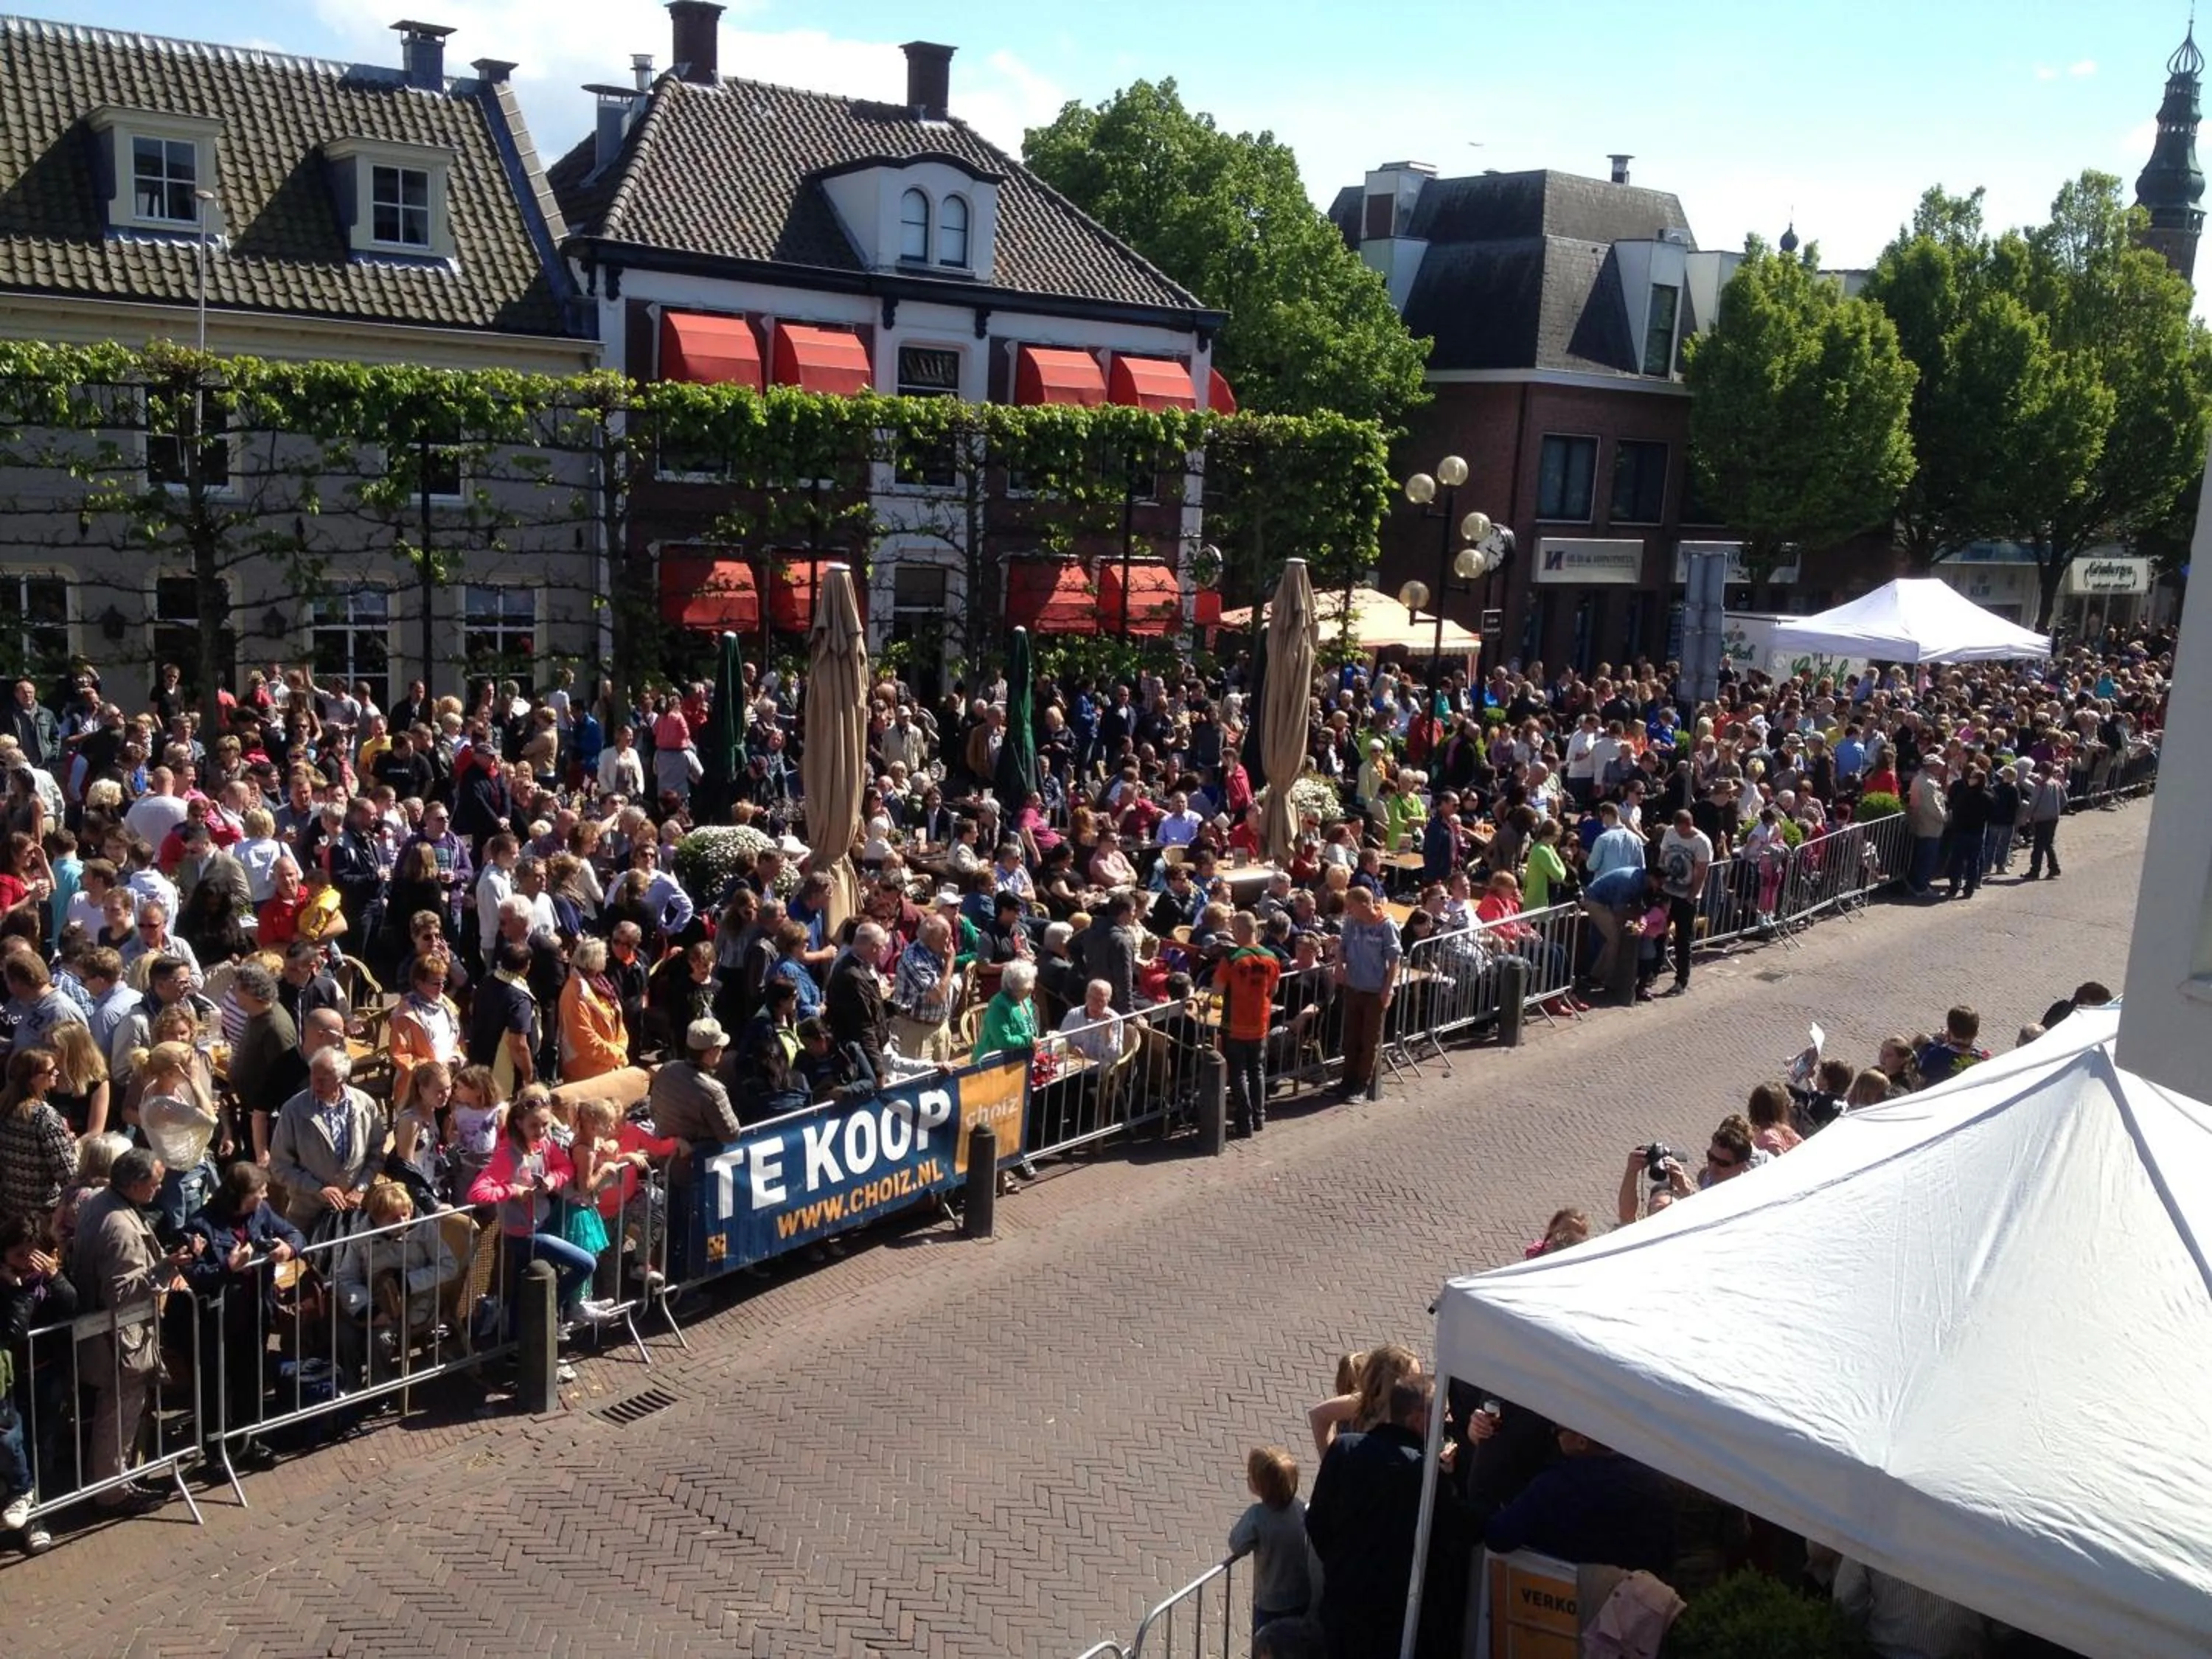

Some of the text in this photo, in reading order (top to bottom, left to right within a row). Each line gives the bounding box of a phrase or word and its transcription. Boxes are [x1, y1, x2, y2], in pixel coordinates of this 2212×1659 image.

[704, 1088, 952, 1220] TE KOOP
[776, 1158, 945, 1239] WWW.CHOIZ.NL
